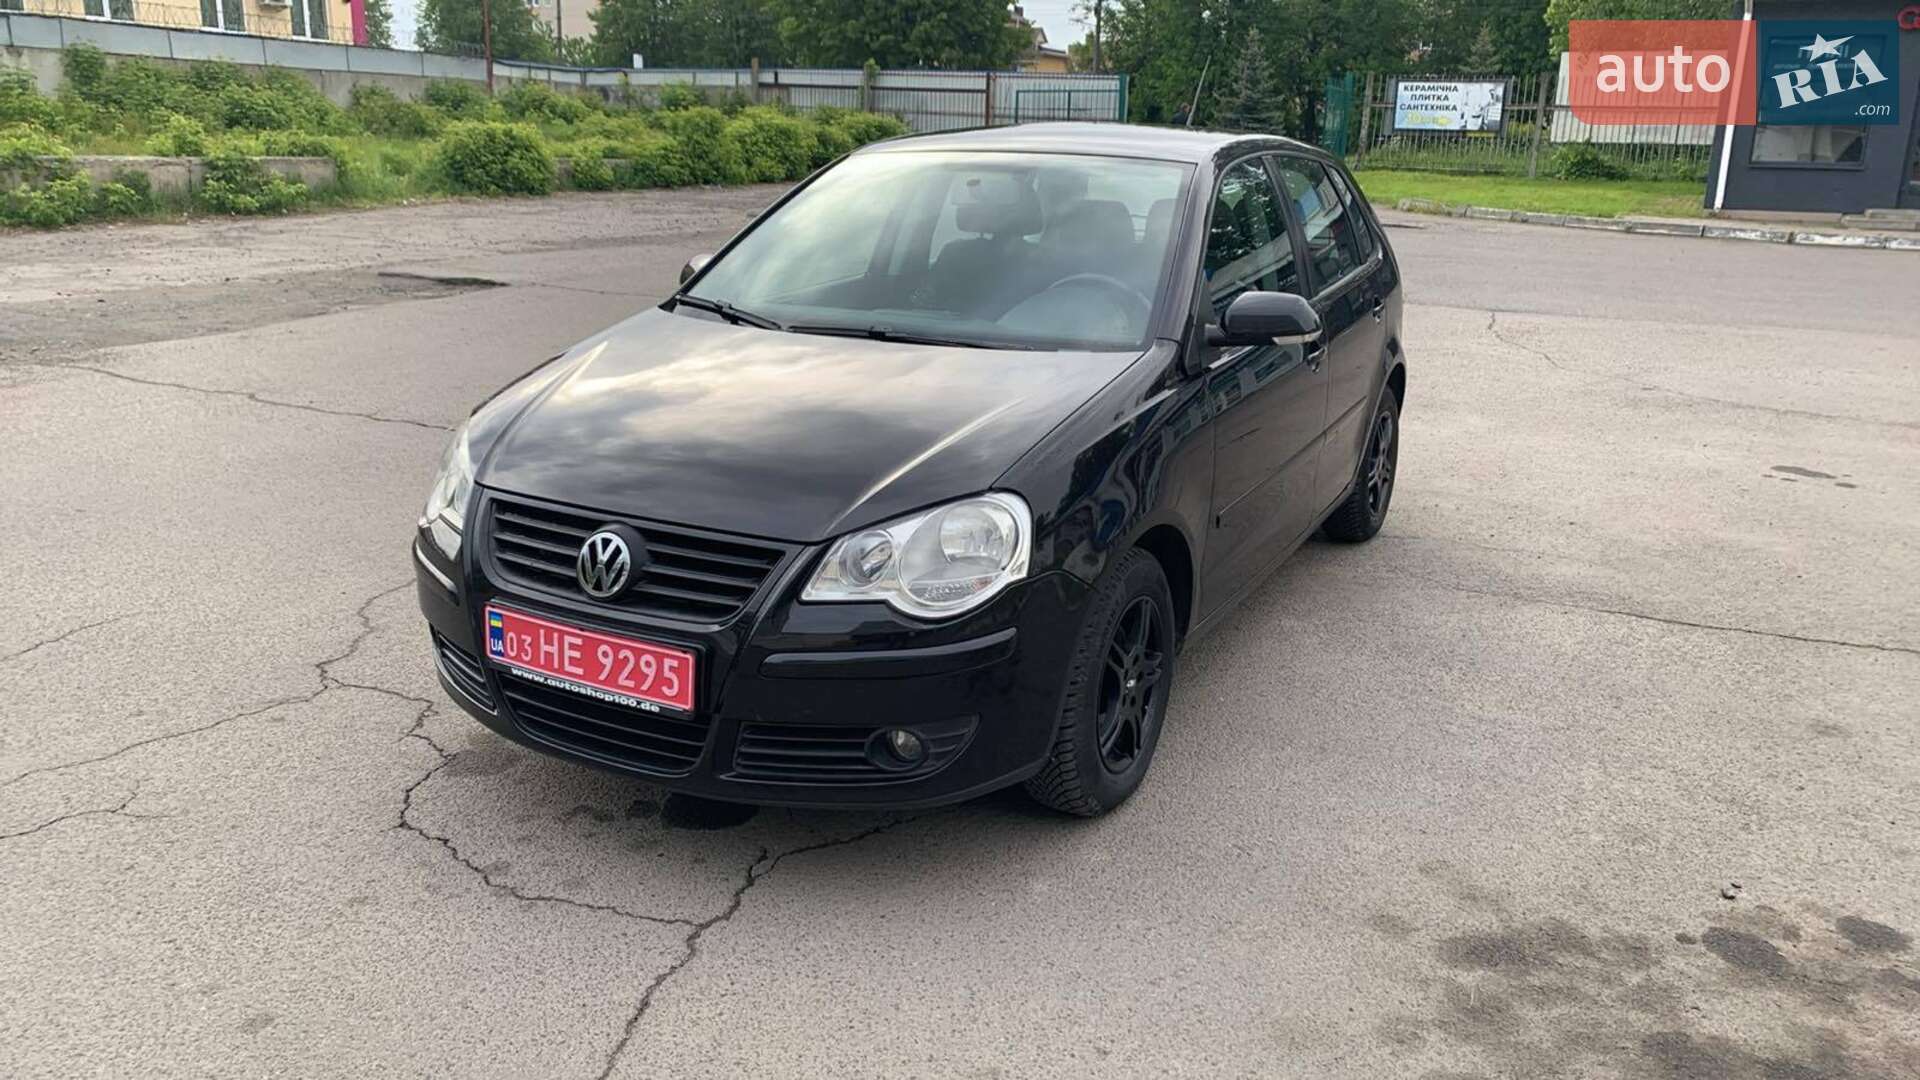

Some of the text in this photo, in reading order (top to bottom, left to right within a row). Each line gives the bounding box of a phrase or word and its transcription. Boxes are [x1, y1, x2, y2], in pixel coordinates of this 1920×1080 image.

[1403, 84, 1458, 92] КЕРАМІЧНА
[1400, 103, 1458, 111] САНТЕХНІКА
[490, 638, 505, 654] UA
[596, 644, 680, 697] 9295
[511, 667, 660, 713] www.autoshop100.de
